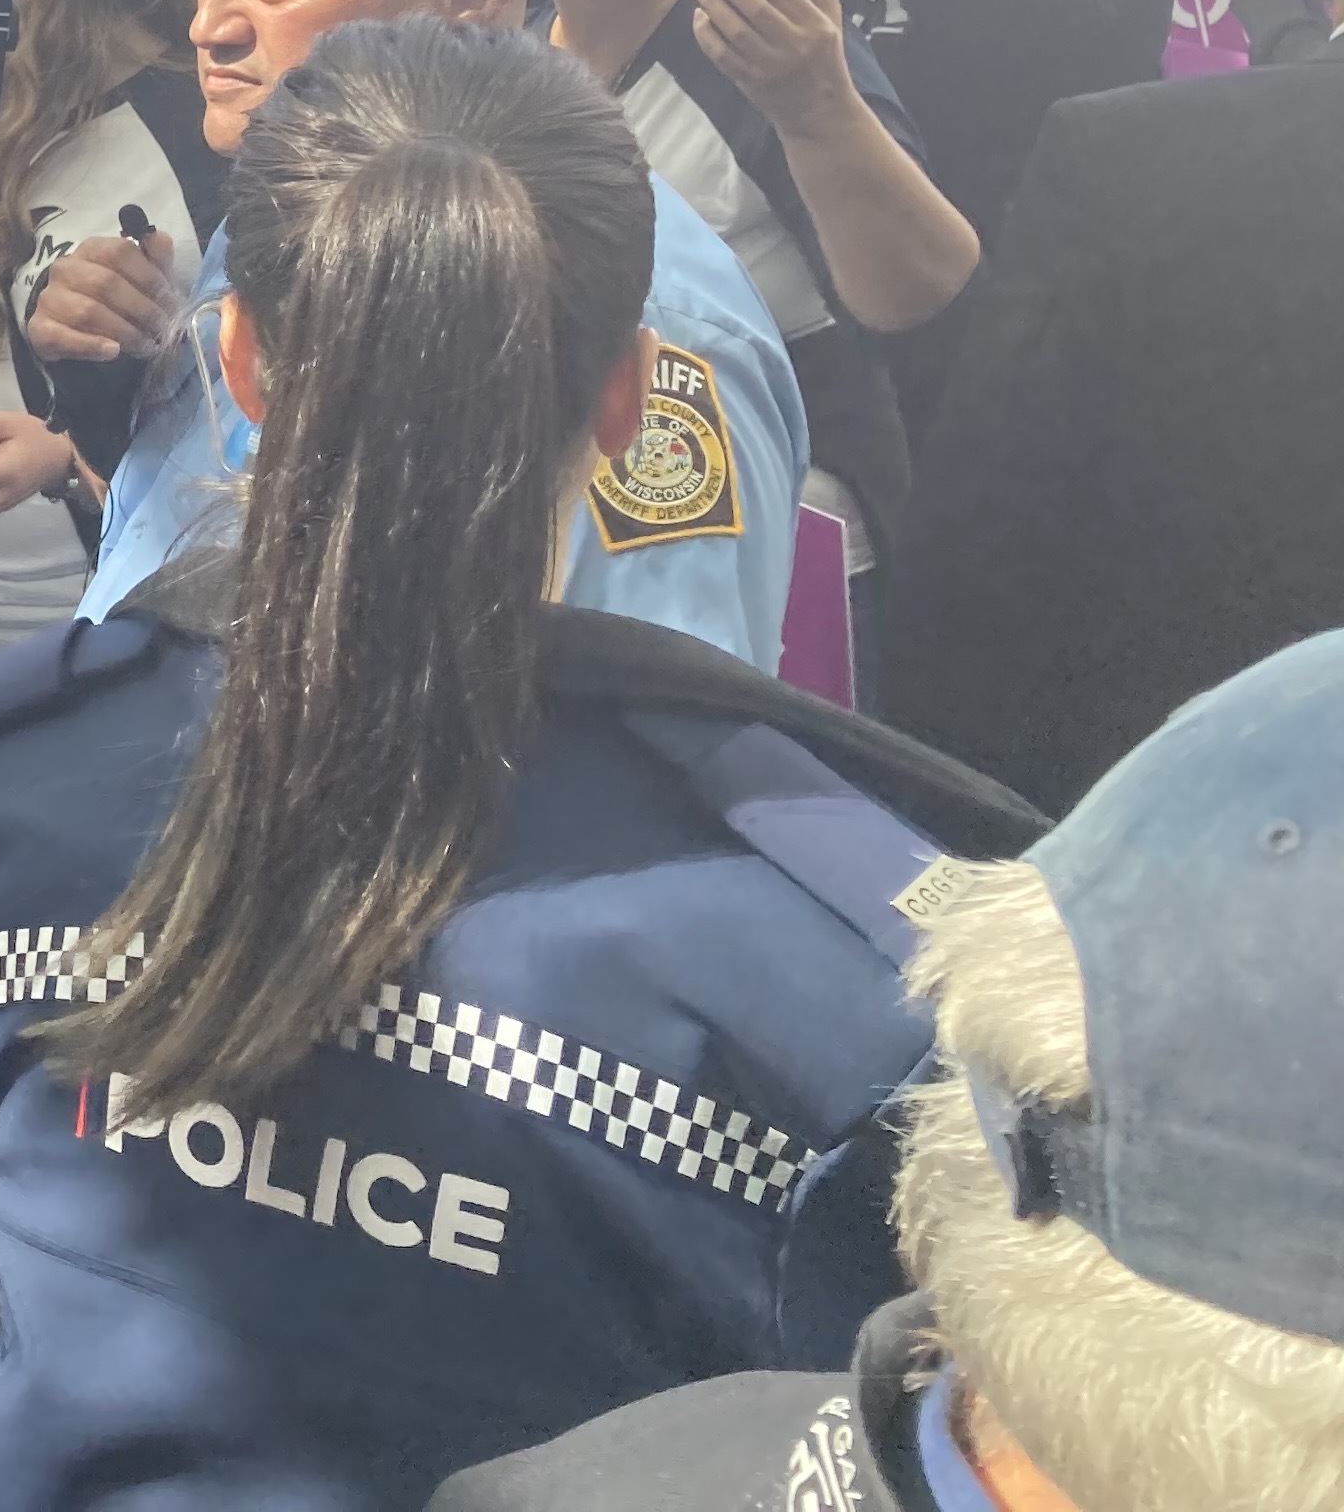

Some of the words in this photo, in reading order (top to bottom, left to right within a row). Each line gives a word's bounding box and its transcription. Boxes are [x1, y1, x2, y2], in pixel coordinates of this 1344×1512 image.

[667, 419, 690, 436] OF
[623, 468, 704, 503] WISCONSIN
[104, 1071, 511, 1275] POLICE
